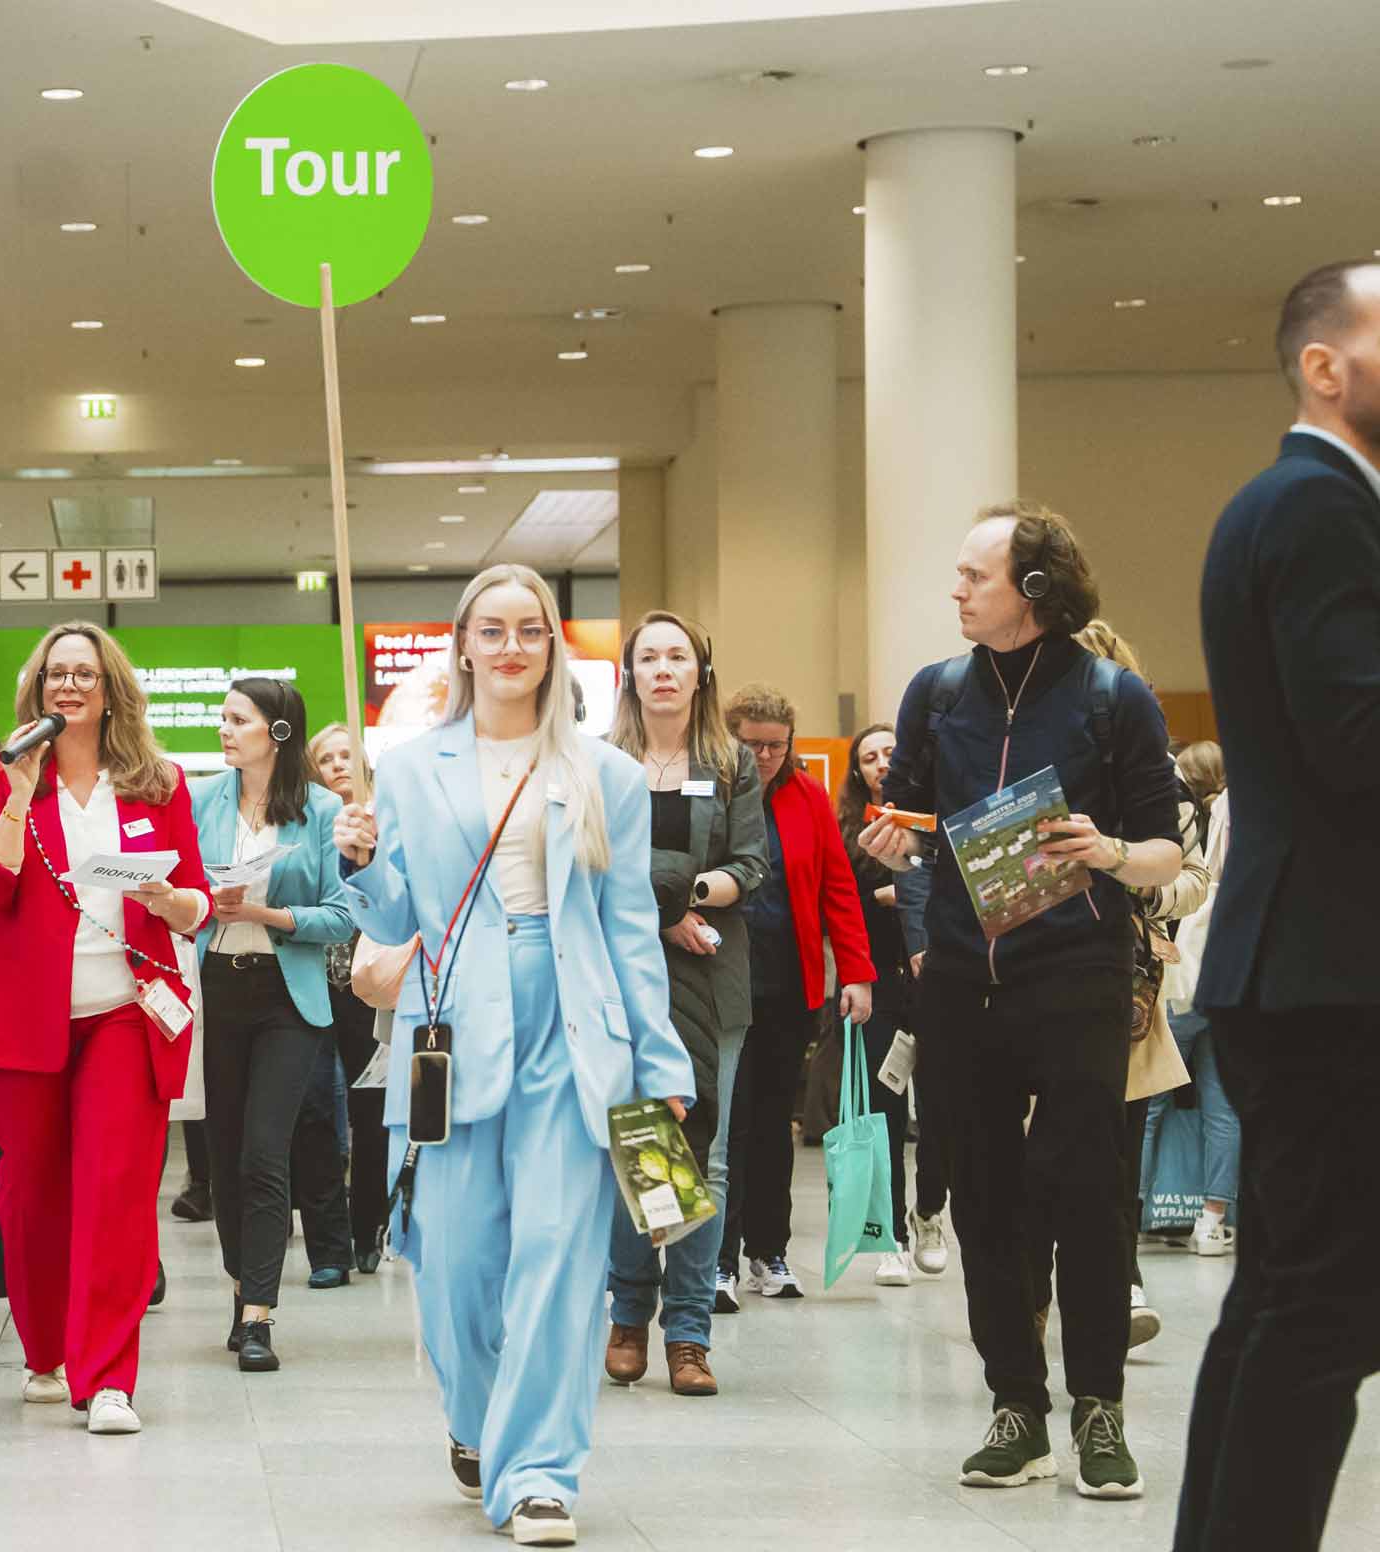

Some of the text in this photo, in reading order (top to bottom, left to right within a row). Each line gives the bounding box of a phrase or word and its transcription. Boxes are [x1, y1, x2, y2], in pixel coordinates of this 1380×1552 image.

[244, 137, 400, 197] Tour
[92, 866, 155, 882] BIOFACH
[1152, 1194, 1180, 1204] WAS
